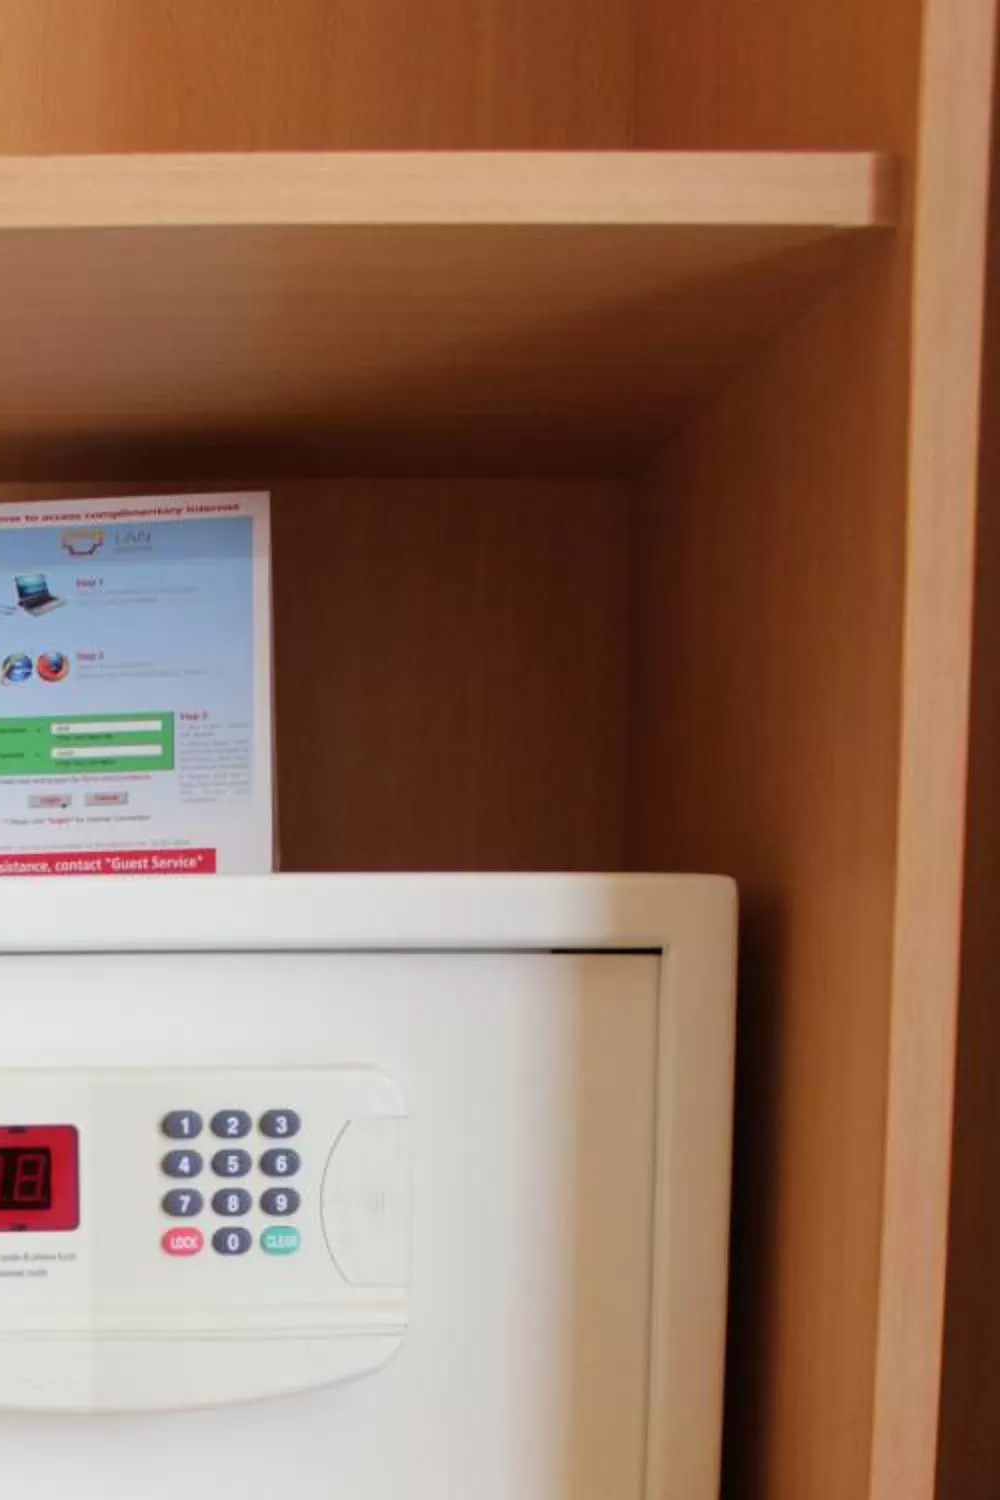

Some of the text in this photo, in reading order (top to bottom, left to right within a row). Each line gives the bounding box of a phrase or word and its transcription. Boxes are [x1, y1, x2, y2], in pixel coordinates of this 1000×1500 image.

[55, 858, 101, 872] contact
[105, 857, 148, 870] "Guest
[151, 855, 204, 869] Service"
[180, 1117, 287, 1134] 1 2 3
[178, 1155, 287, 1173] 4 5 6
[179, 1195, 287, 1212] 7 8 9
[170, 1234, 298, 1250] LOCK 0 CLEAR
